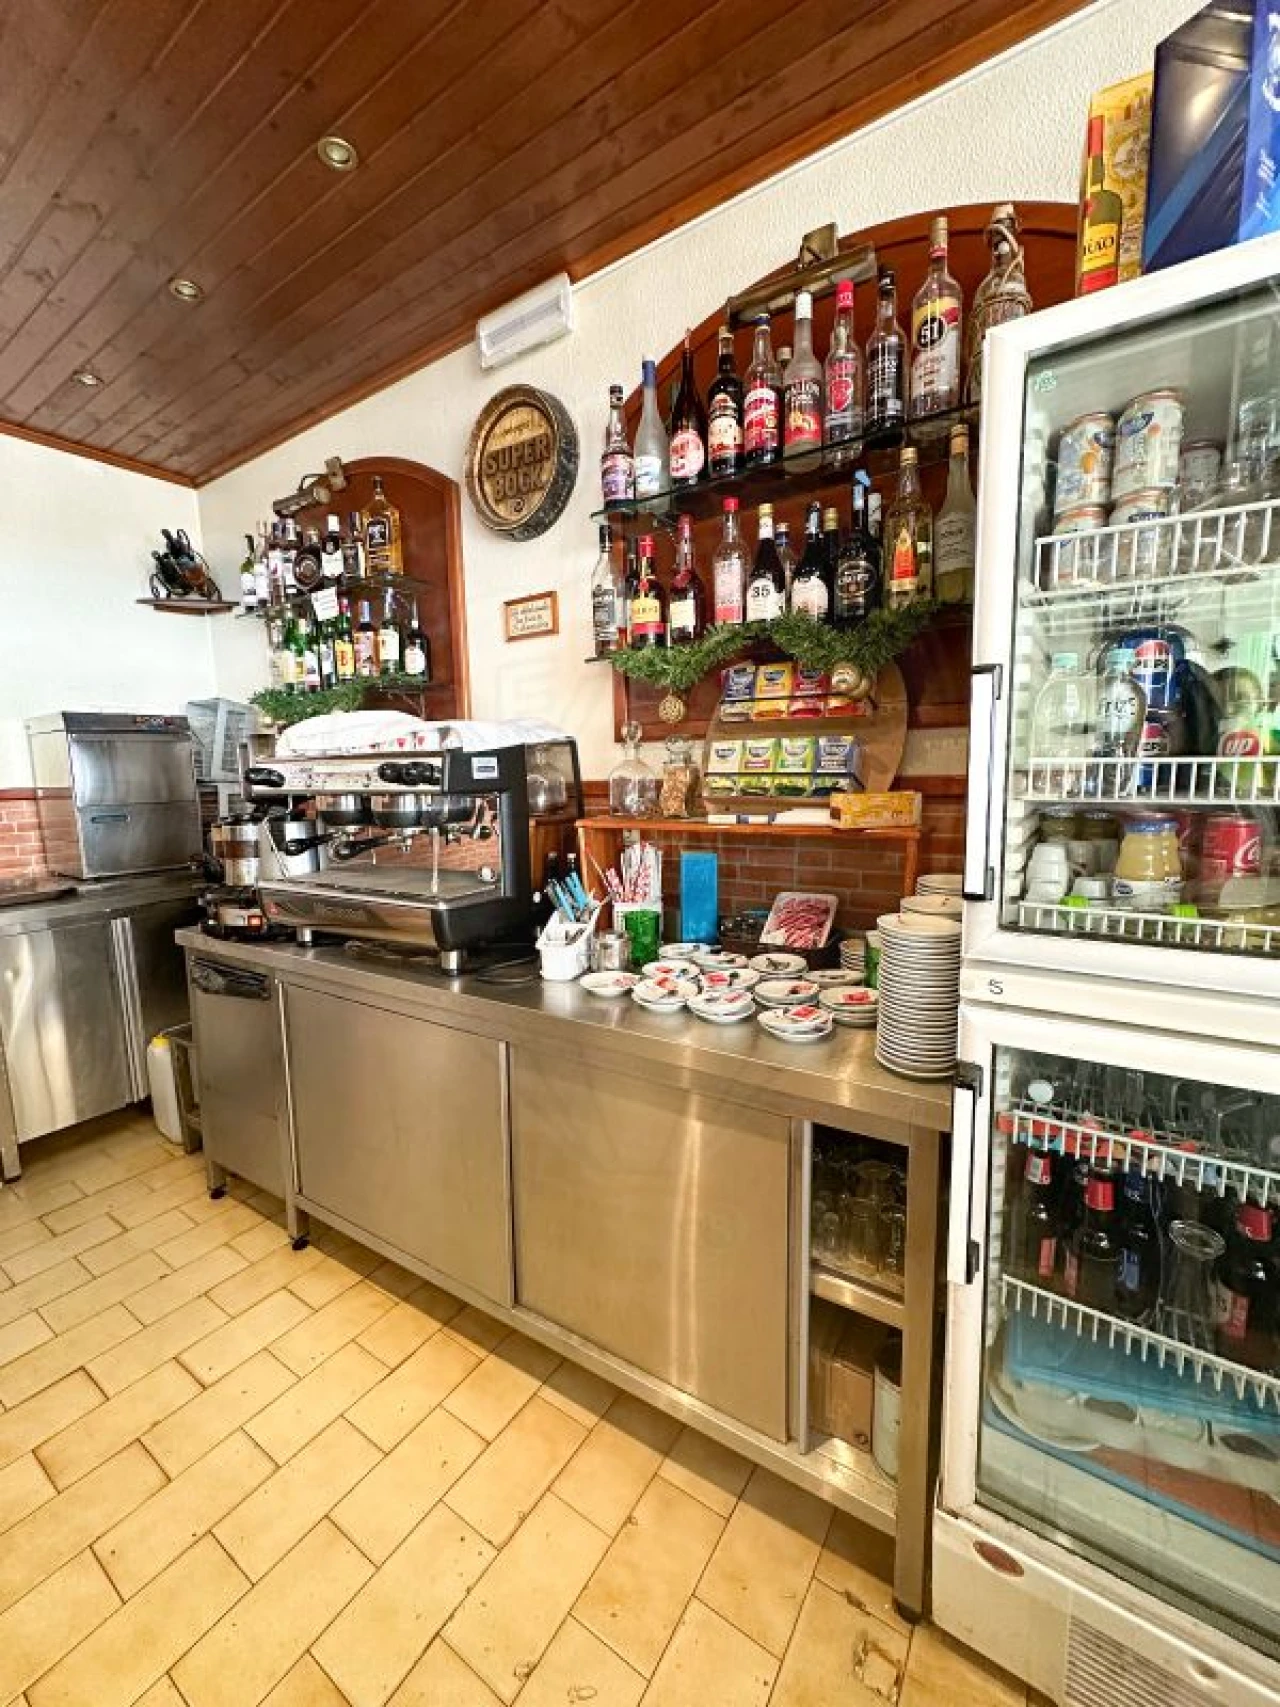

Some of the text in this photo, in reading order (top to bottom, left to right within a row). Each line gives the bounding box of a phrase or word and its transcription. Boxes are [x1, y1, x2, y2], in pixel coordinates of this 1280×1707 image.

[484, 433, 551, 476] SUPER
[494, 462, 545, 501] BOCK
[751, 584, 771, 597] 35
